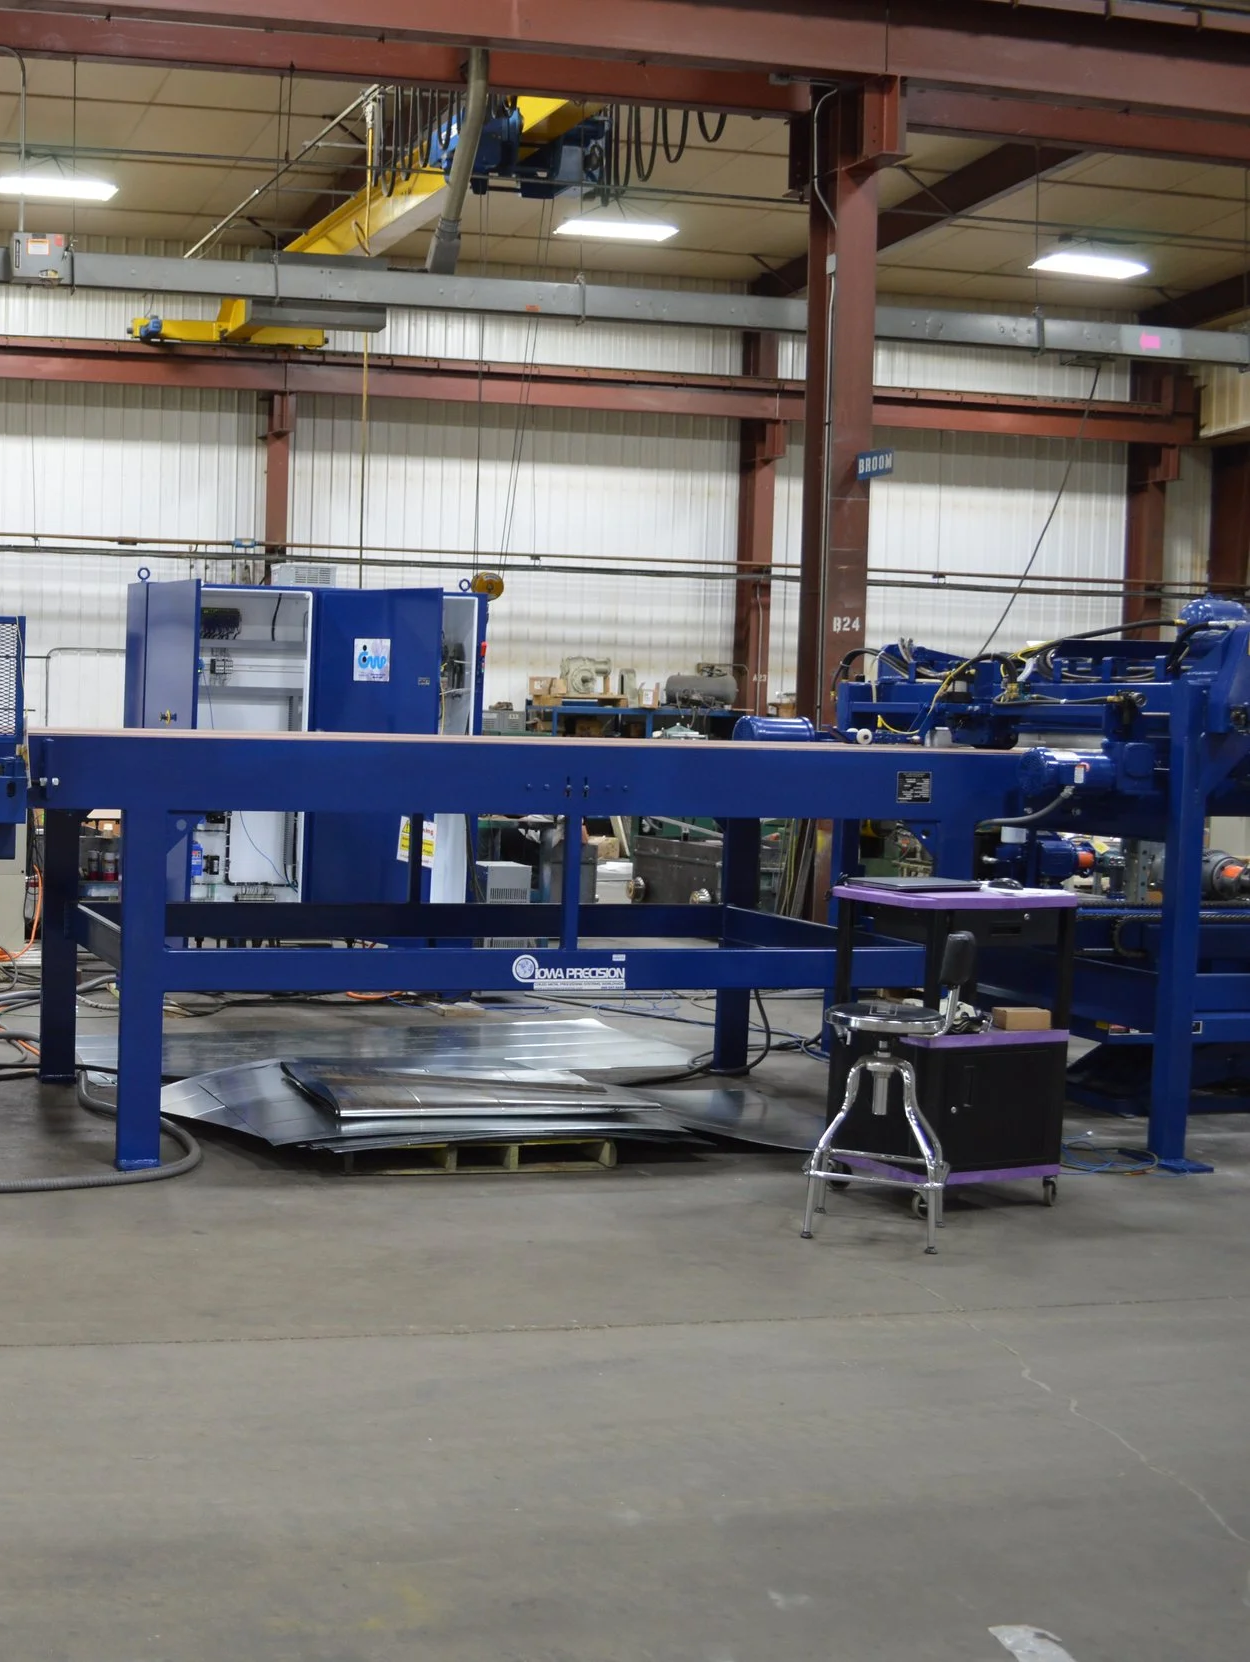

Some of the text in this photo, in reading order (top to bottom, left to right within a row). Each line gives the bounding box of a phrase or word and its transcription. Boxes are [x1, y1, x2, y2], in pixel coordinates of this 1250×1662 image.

[858, 453, 892, 474] BROOM
[833, 616, 860, 632] B24
[534, 967, 626, 979] IOWA PRECISION
